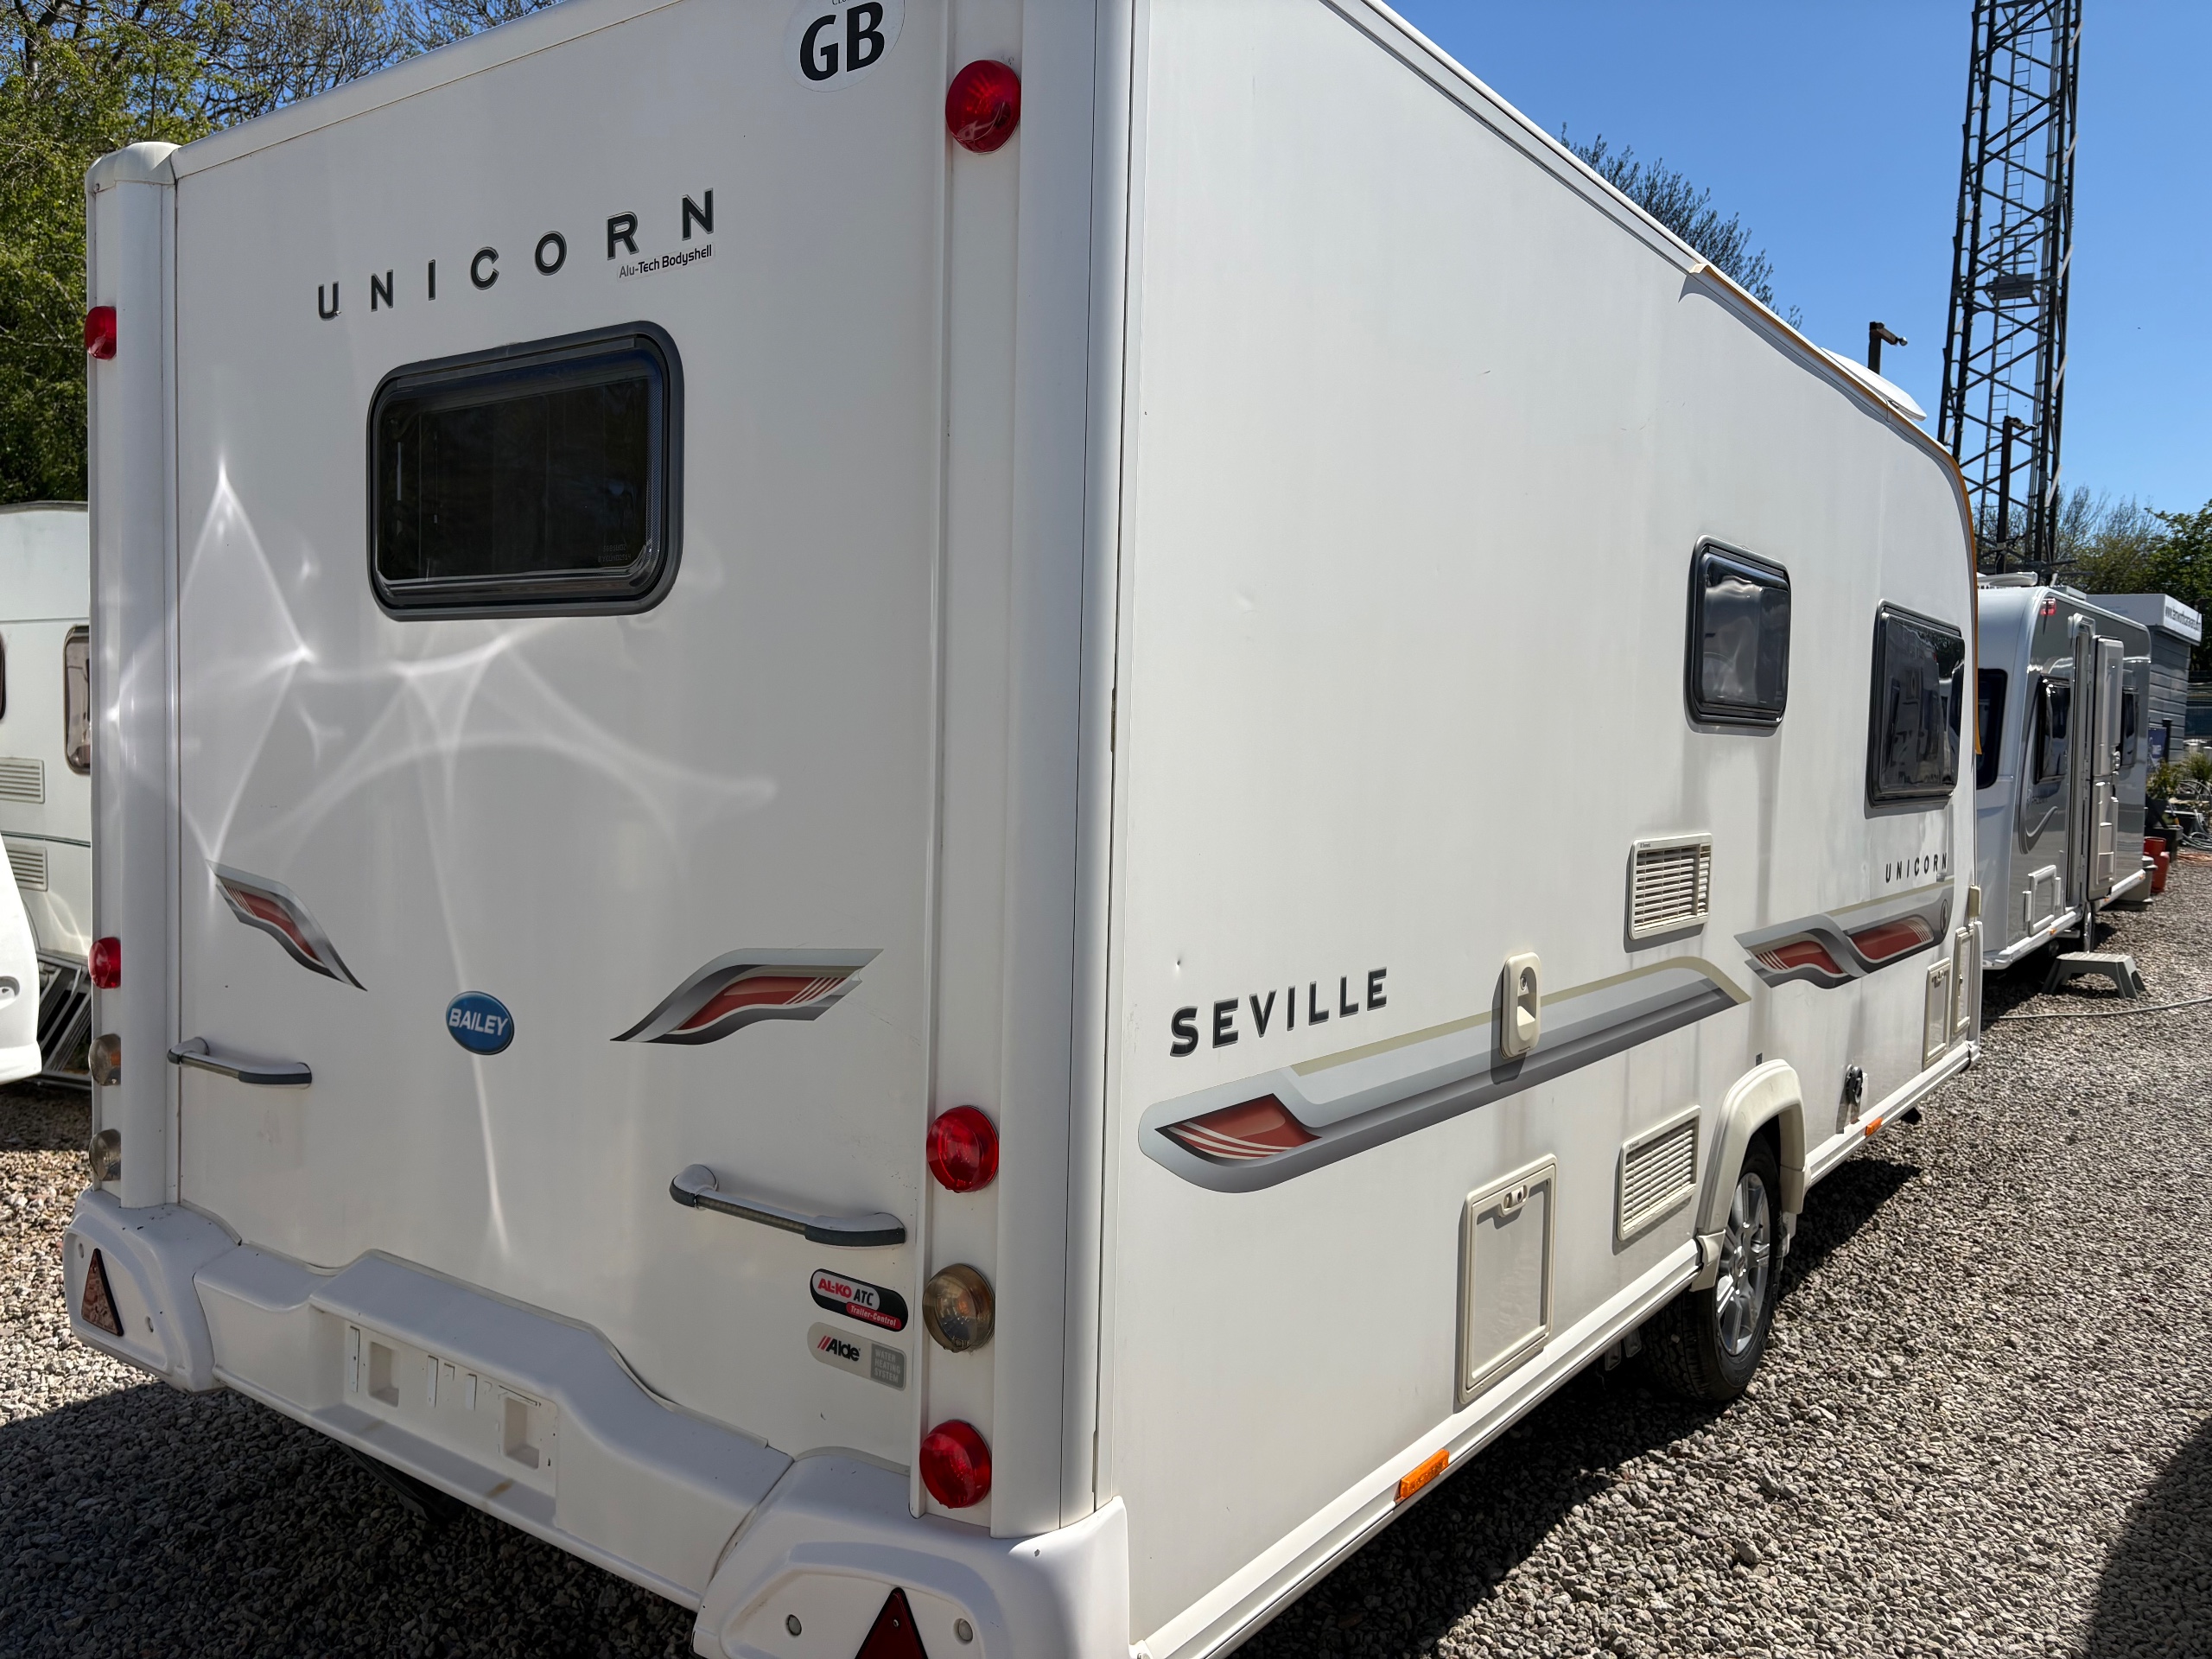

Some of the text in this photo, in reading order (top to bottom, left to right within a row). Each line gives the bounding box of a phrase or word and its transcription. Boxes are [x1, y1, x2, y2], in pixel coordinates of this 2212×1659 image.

[800, 2, 885, 81] GB
[318, 188, 714, 321] UNICORN
[620, 244, 712, 278] Alu-Tech Bodyshell
[1885, 852, 1947, 883] UNICORN
[449, 1007, 508, 1036] BAILEY
[1170, 967, 1387, 1057] SEVILLE
[817, 1278, 874, 1306] AL-KO ATC
[850, 1305, 897, 1327] Trailer-Control
[826, 1338, 861, 1362] Alde
[874, 1349, 896, 1363] WATER
[874, 1357, 900, 1375] HEATING
[874, 1367, 899, 1383] SYSTEM
